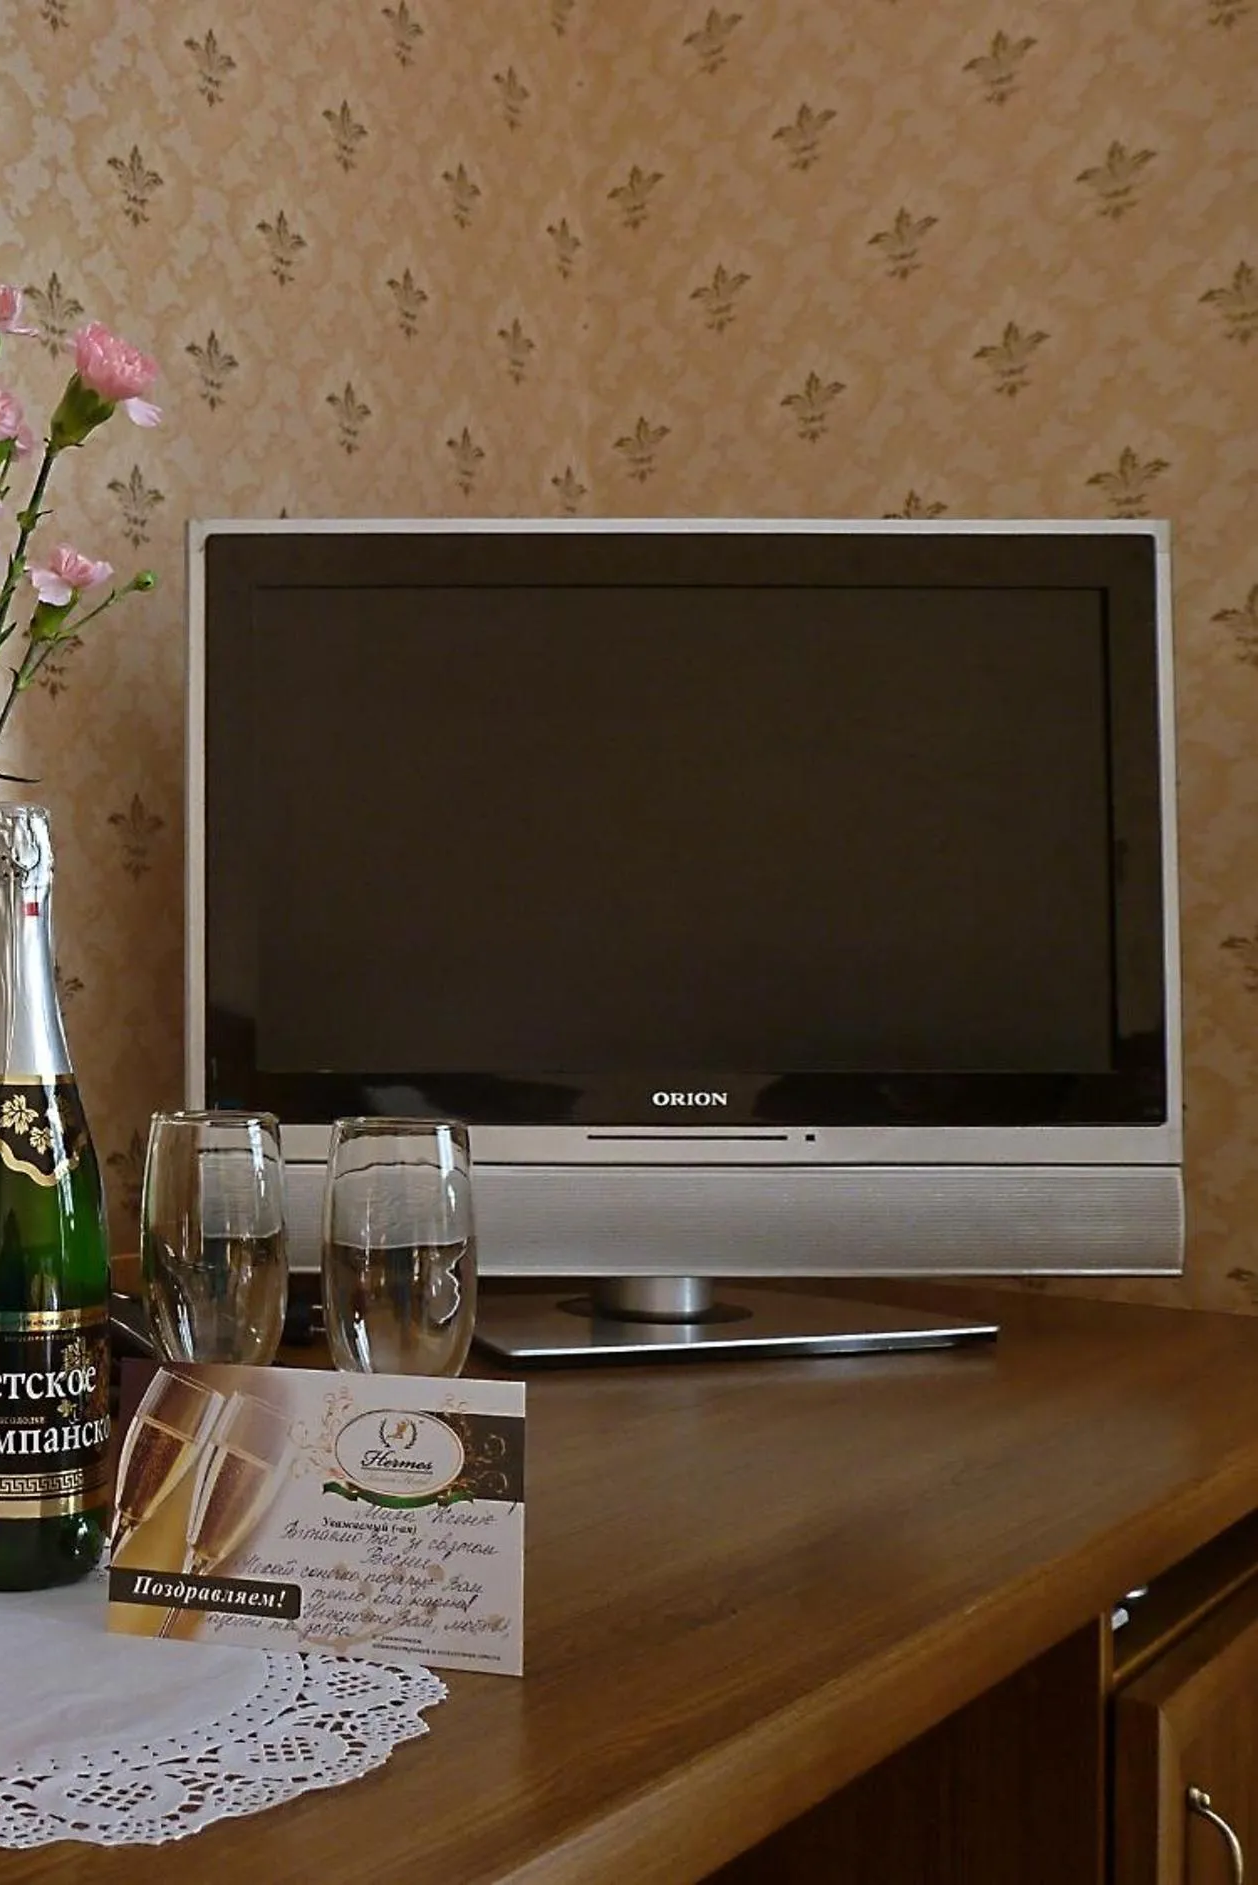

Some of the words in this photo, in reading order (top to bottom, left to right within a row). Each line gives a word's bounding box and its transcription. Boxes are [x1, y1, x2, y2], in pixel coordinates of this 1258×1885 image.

[651, 1091, 728, 1107] ORION
[360, 1449, 434, 1470] Hermes
[133, 1576, 287, 1609] Поздравляем!
